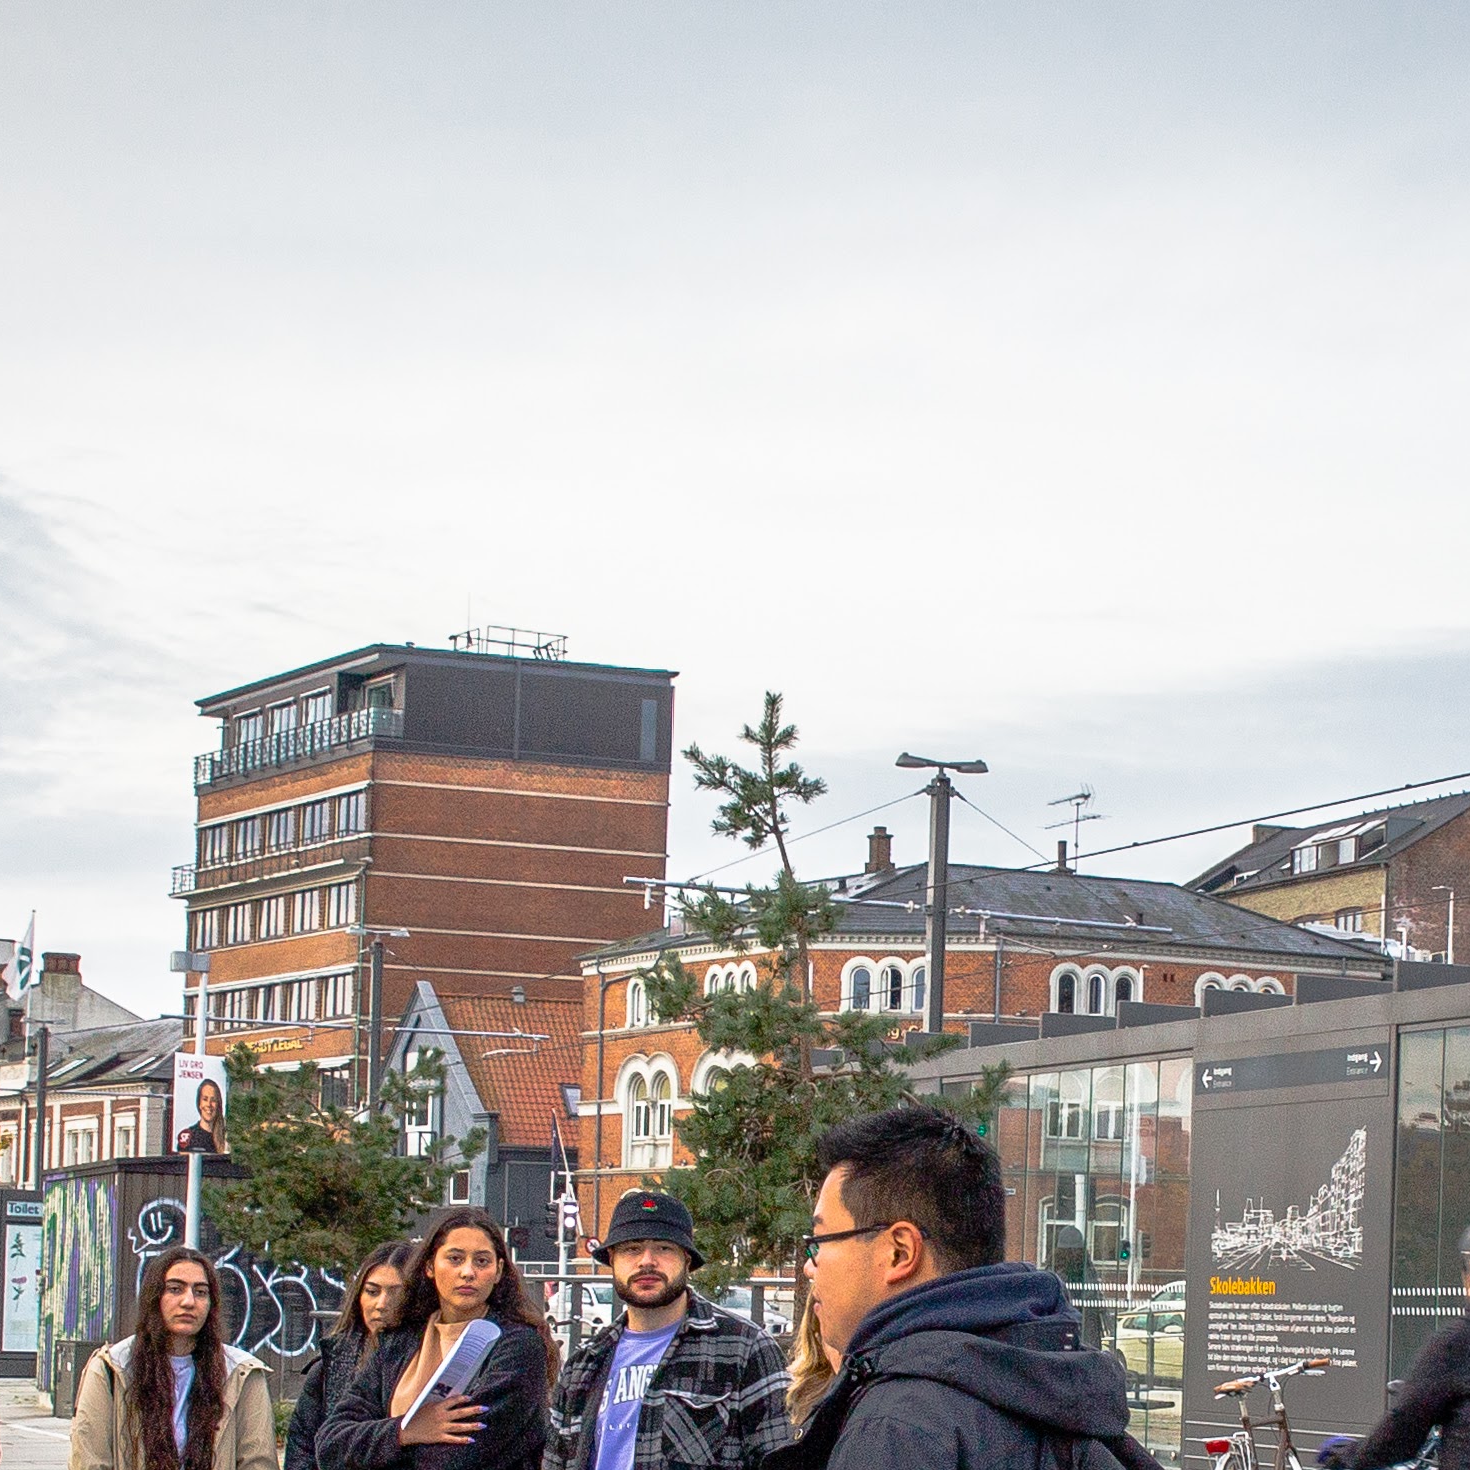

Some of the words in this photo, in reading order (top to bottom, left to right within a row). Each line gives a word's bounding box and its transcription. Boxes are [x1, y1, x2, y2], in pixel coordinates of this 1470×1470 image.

[190, 1060, 204, 1069] GRO
[178, 1070, 204, 1080] JENSEN
[8, 1202, 39, 1215] Toilet
[1209, 1275, 1276, 1296] Skolebakken
[613, 1364, 659, 1404] ANG
